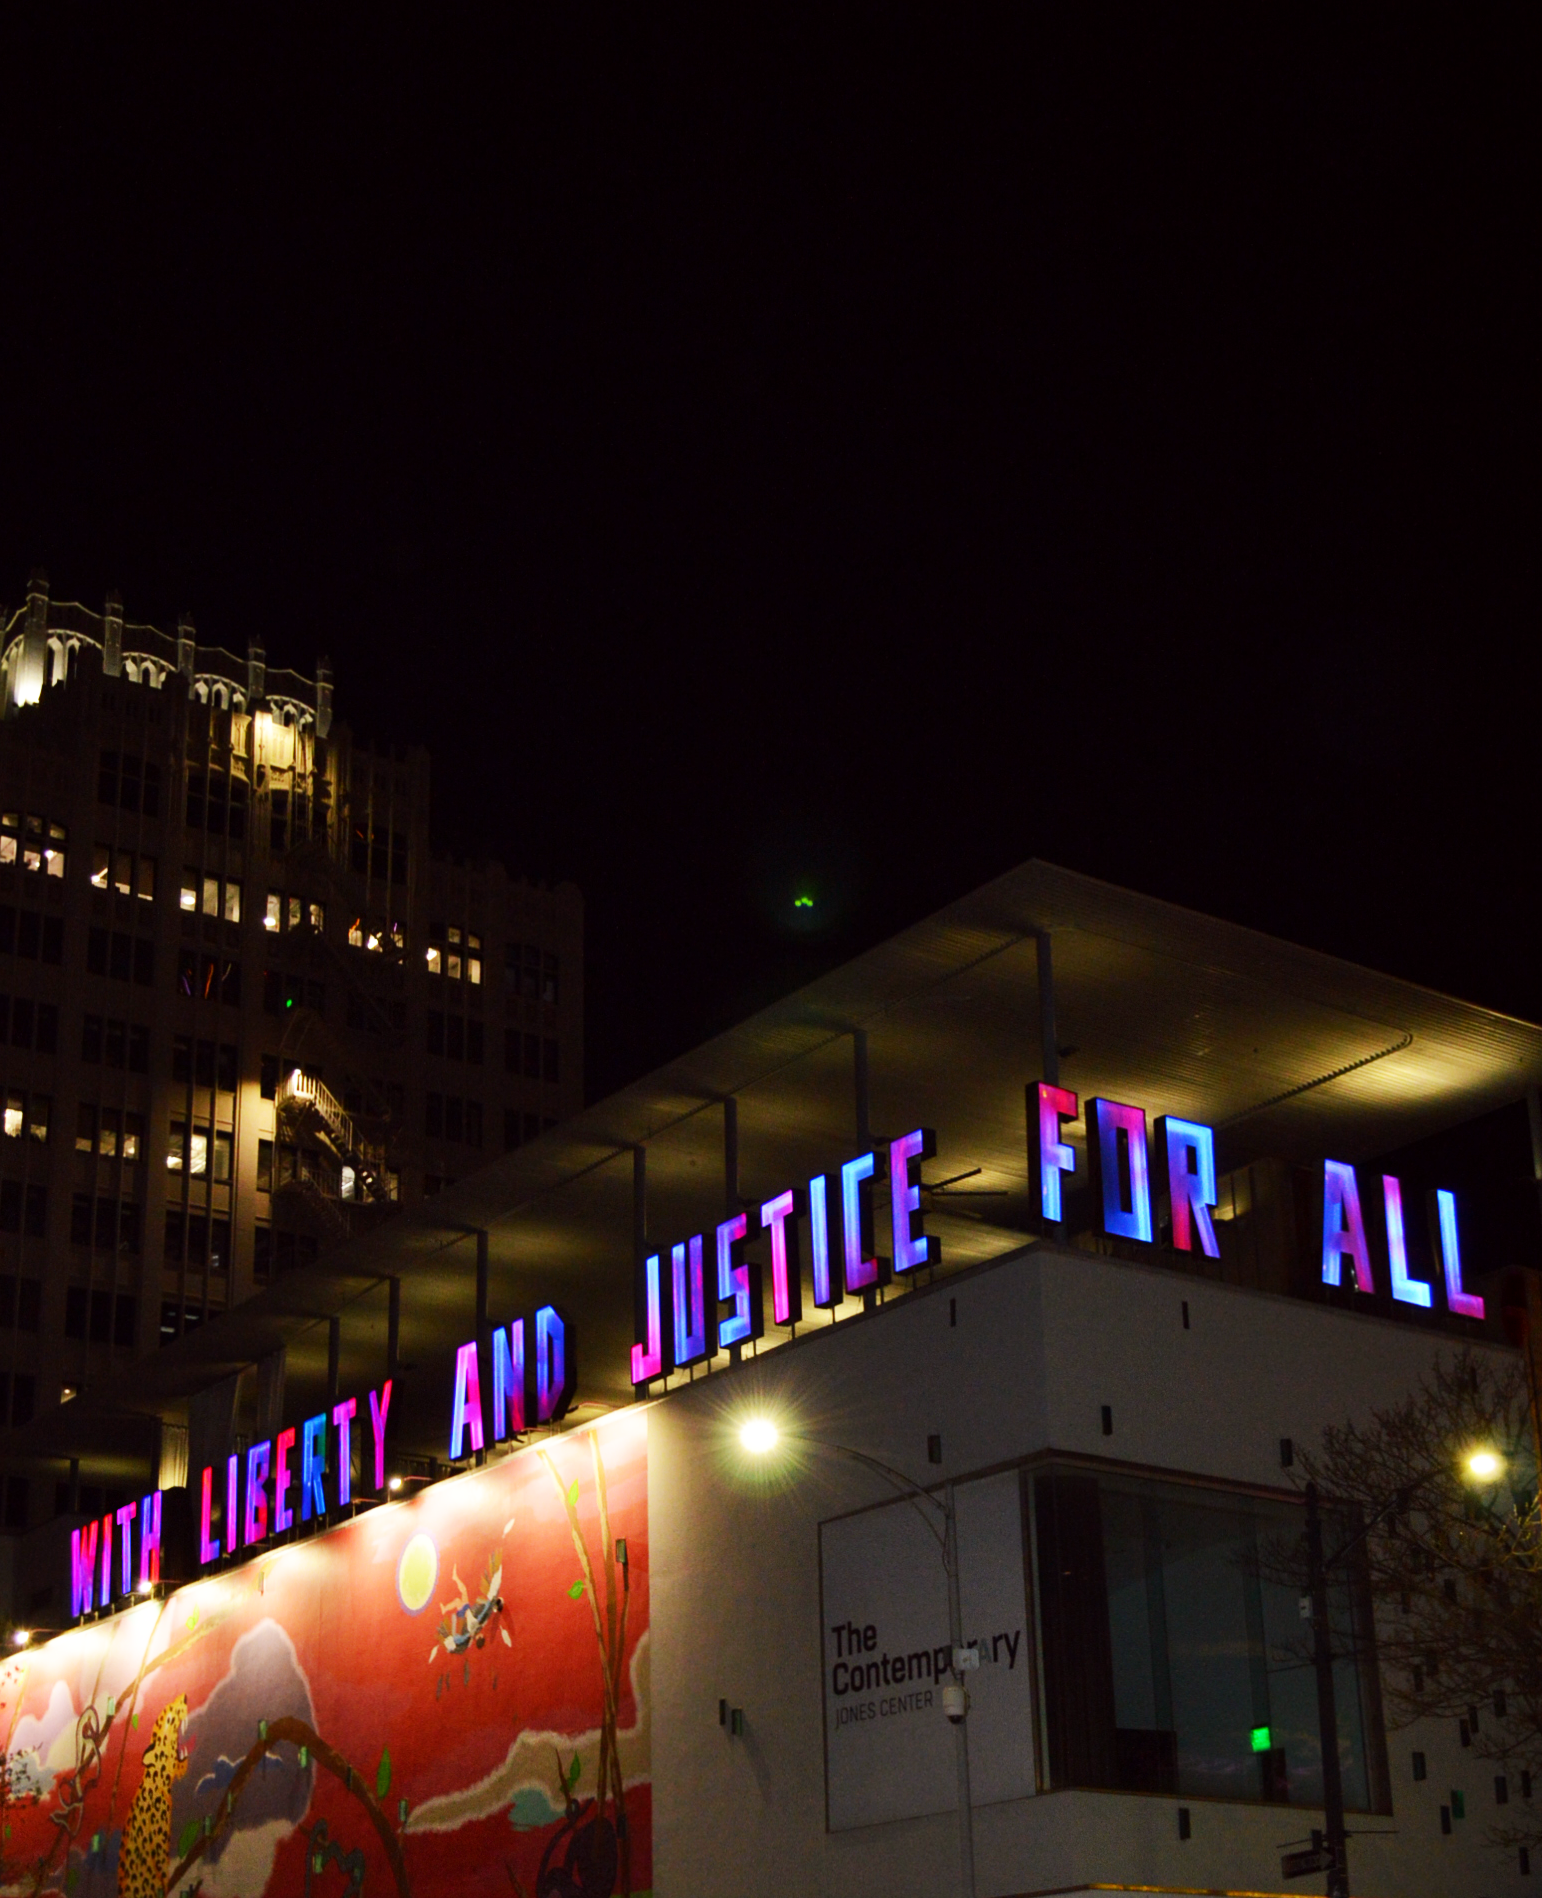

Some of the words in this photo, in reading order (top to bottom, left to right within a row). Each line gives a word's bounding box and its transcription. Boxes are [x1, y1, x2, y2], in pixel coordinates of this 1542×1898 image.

[71, 1489, 163, 1619] WITH
[200, 1379, 393, 1565] LIBERTY
[449, 1305, 566, 1461] AND
[630, 1128, 929, 1385] JUSTICE
[1036, 1082, 1220, 1258] FOR
[1320, 1158, 1485, 1320] ALL
[831, 1621, 878, 1658] The
[832, 1630, 1021, 1696] Contempry
[836, 1702, 876, 1729] JONES
[880, 1690, 934, 1717] CENTER
